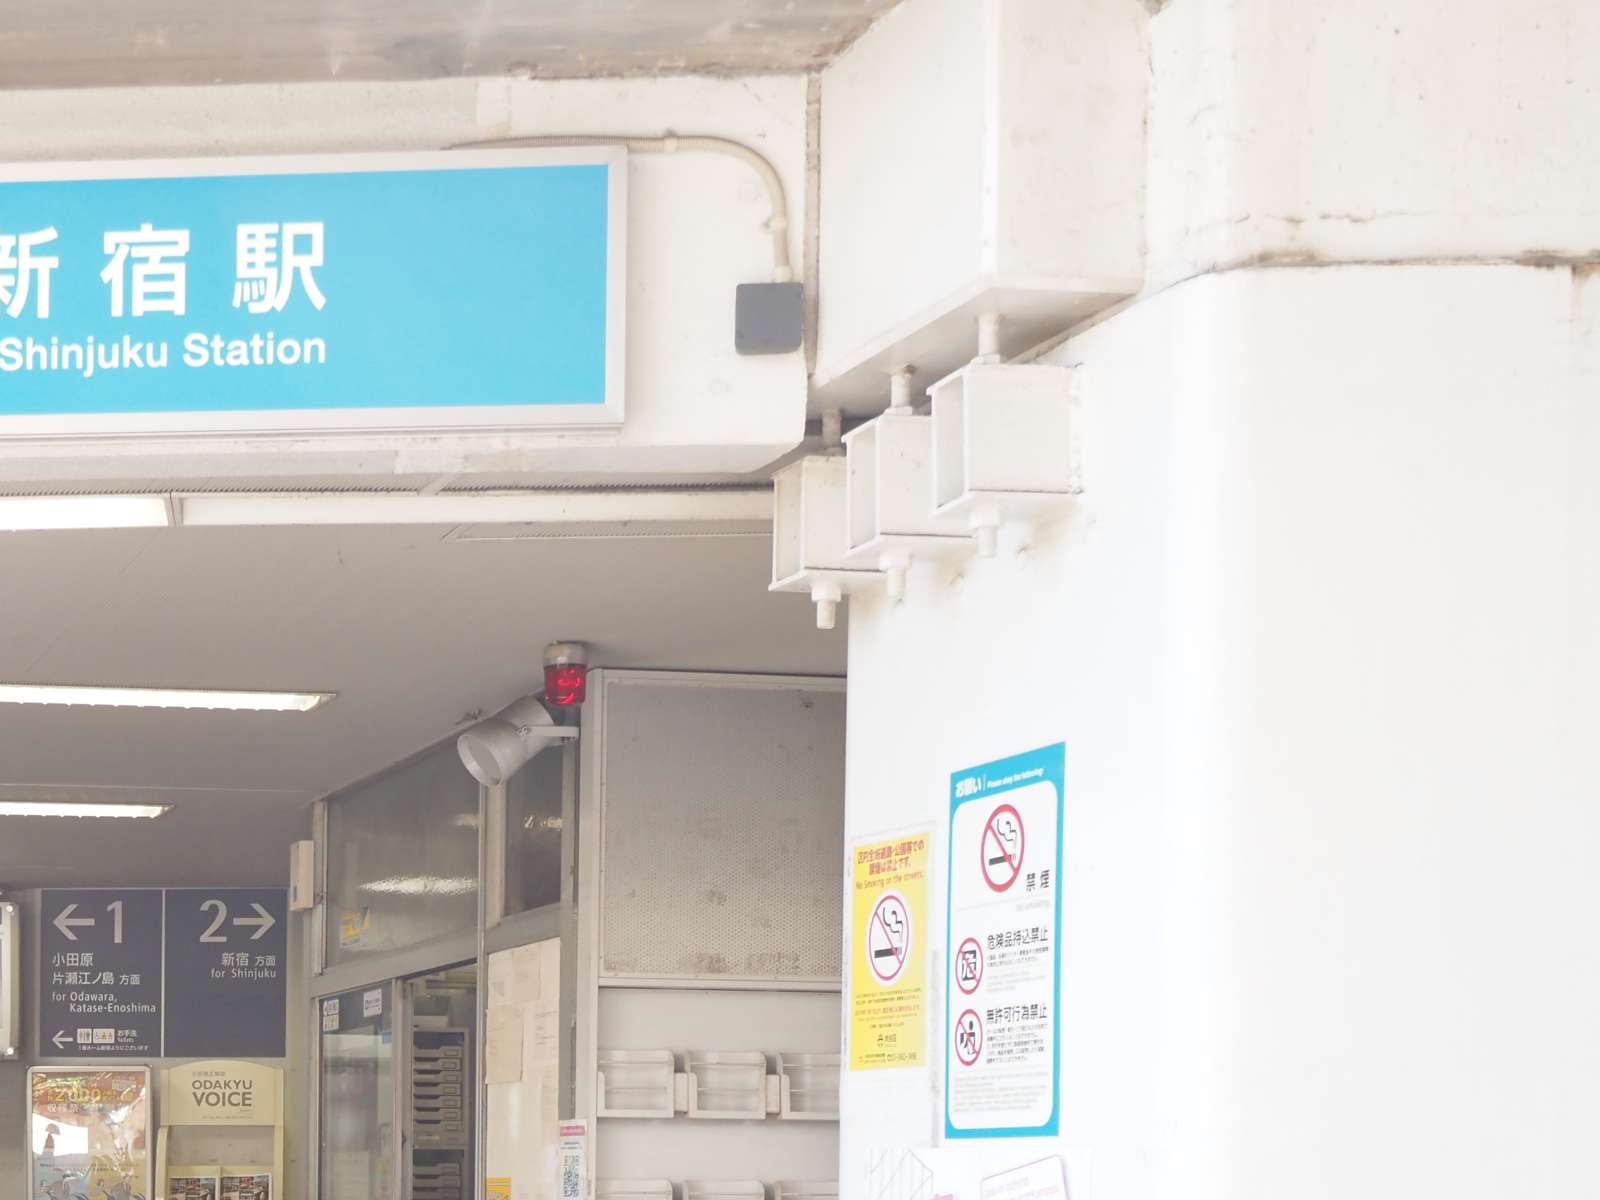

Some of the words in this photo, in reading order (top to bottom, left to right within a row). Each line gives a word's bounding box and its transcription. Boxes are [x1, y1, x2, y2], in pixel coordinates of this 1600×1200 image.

[183, 330, 329, 367] Station
[856, 881, 863, 890] No
[864, 878, 885, 888] Smoking
[886, 876, 892, 884] on
[893, 874, 902, 883] the
[1026, 869, 1050, 892] 禁煙
[106, 900, 123, 944] 1
[199, 899, 228, 943] 2
[987, 924, 1048, 951] 危険品持込禁止
[52, 953, 94, 967] 小田原
[221, 952, 249, 967] 新宿
[254, 955, 276, 966] 方面
[52, 972, 115, 986] 片瀬江ノ島
[119, 974, 141, 986] 方面
[211, 968, 226, 978] for
[231, 968, 277, 980] Shinjuku
[52, 991, 66, 1001] for
[70, 991, 118, 1003] Odawara,
[69, 1002, 156, 1013] Katase-Enoshima
[986, 1002, 1048, 1025] 無許可行為禁止
[191, 1079, 253, 1090] ODAKYU
[191, 1091, 253, 1107] VOICE
